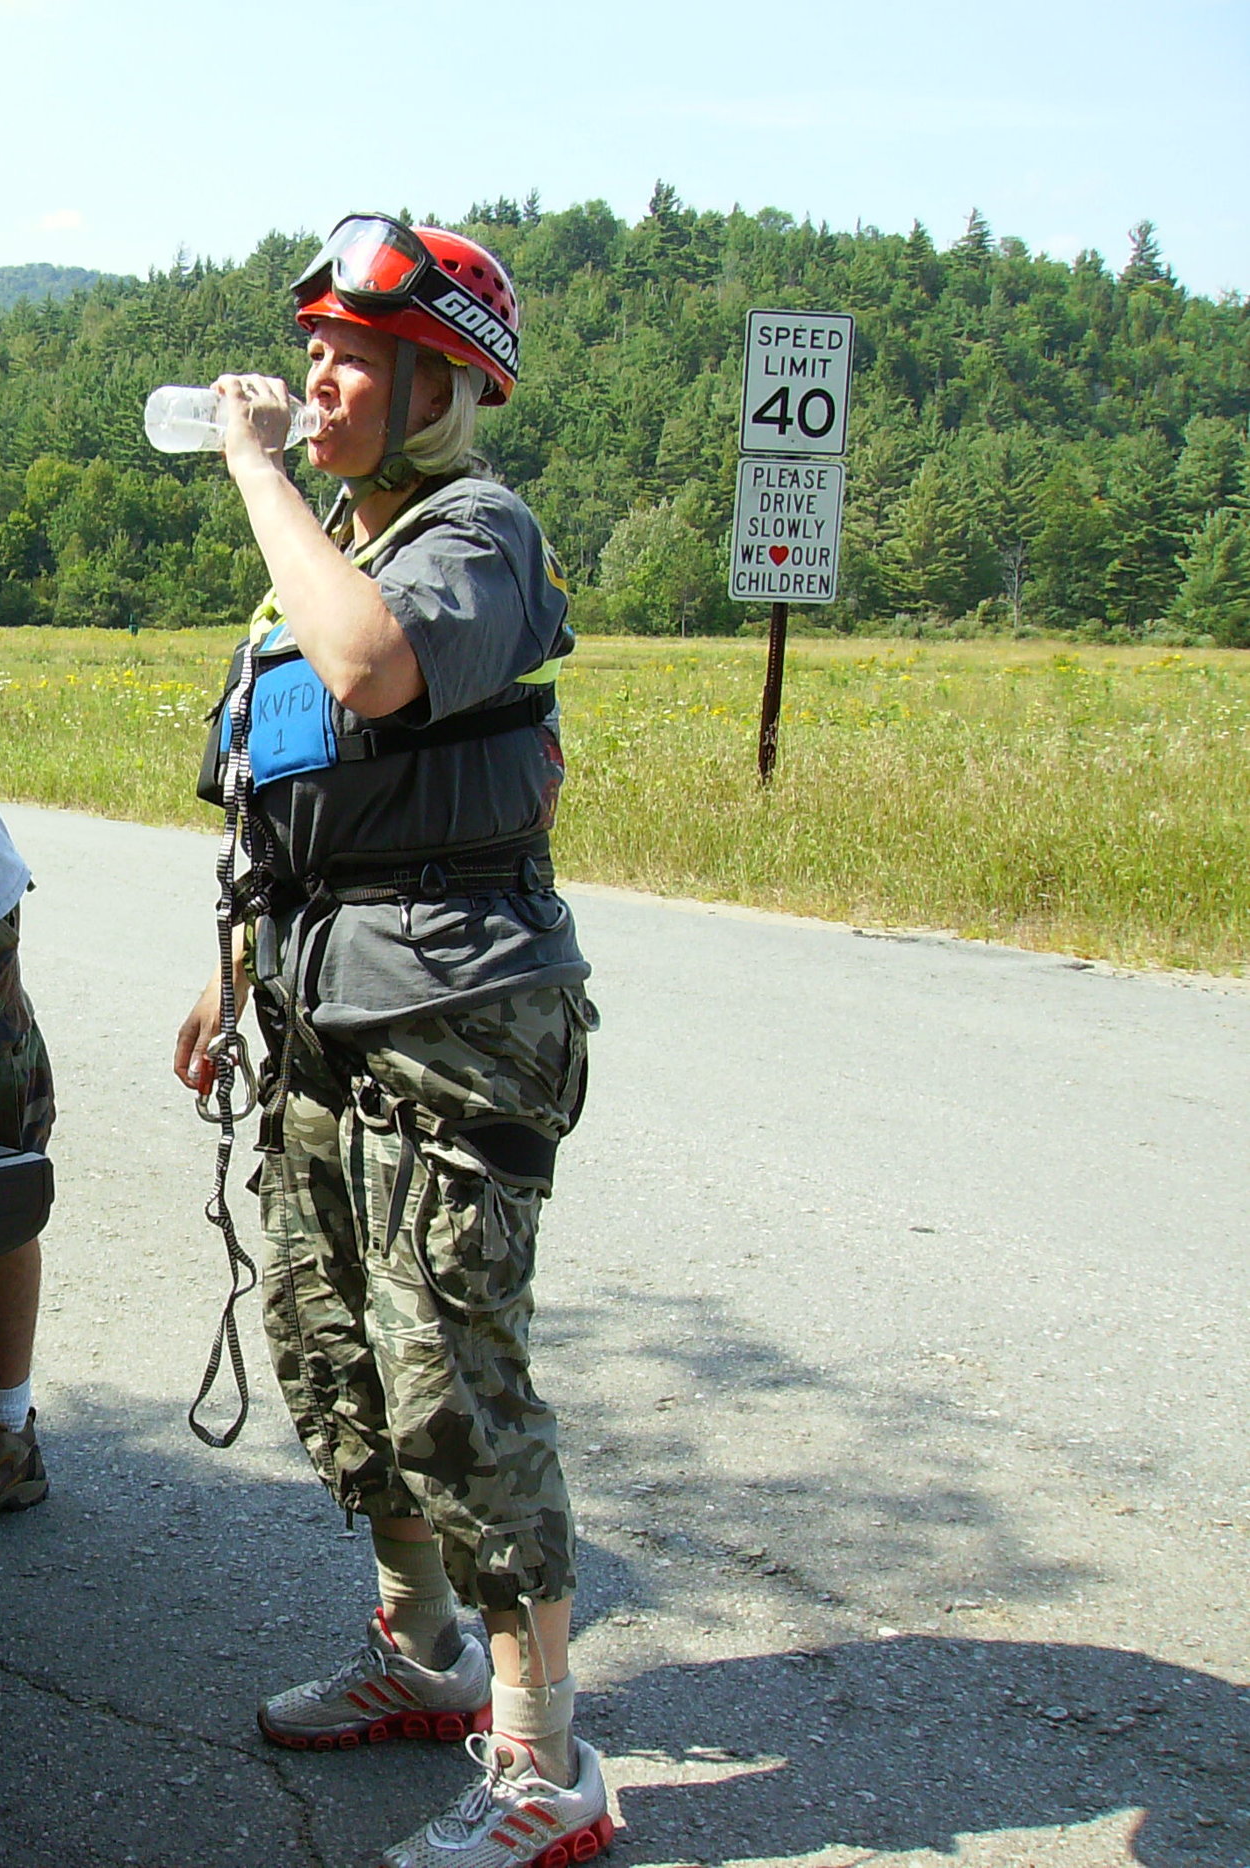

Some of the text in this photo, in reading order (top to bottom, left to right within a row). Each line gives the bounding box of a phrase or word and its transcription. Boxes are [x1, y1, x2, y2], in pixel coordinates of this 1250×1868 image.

[757, 325, 844, 351] SPEED
[764, 354, 832, 379] LIMIT
[751, 386, 836, 439] 40
[753, 467, 828, 491] PLEASE
[759, 492, 818, 515] DRIVE
[748, 517, 826, 540] SLOWLY
[740, 544, 831, 567] WE OUR
[736, 571, 831, 595] CHILDREN
[258, 682, 316, 726] KVFD
[272, 728, 287, 756] 1
